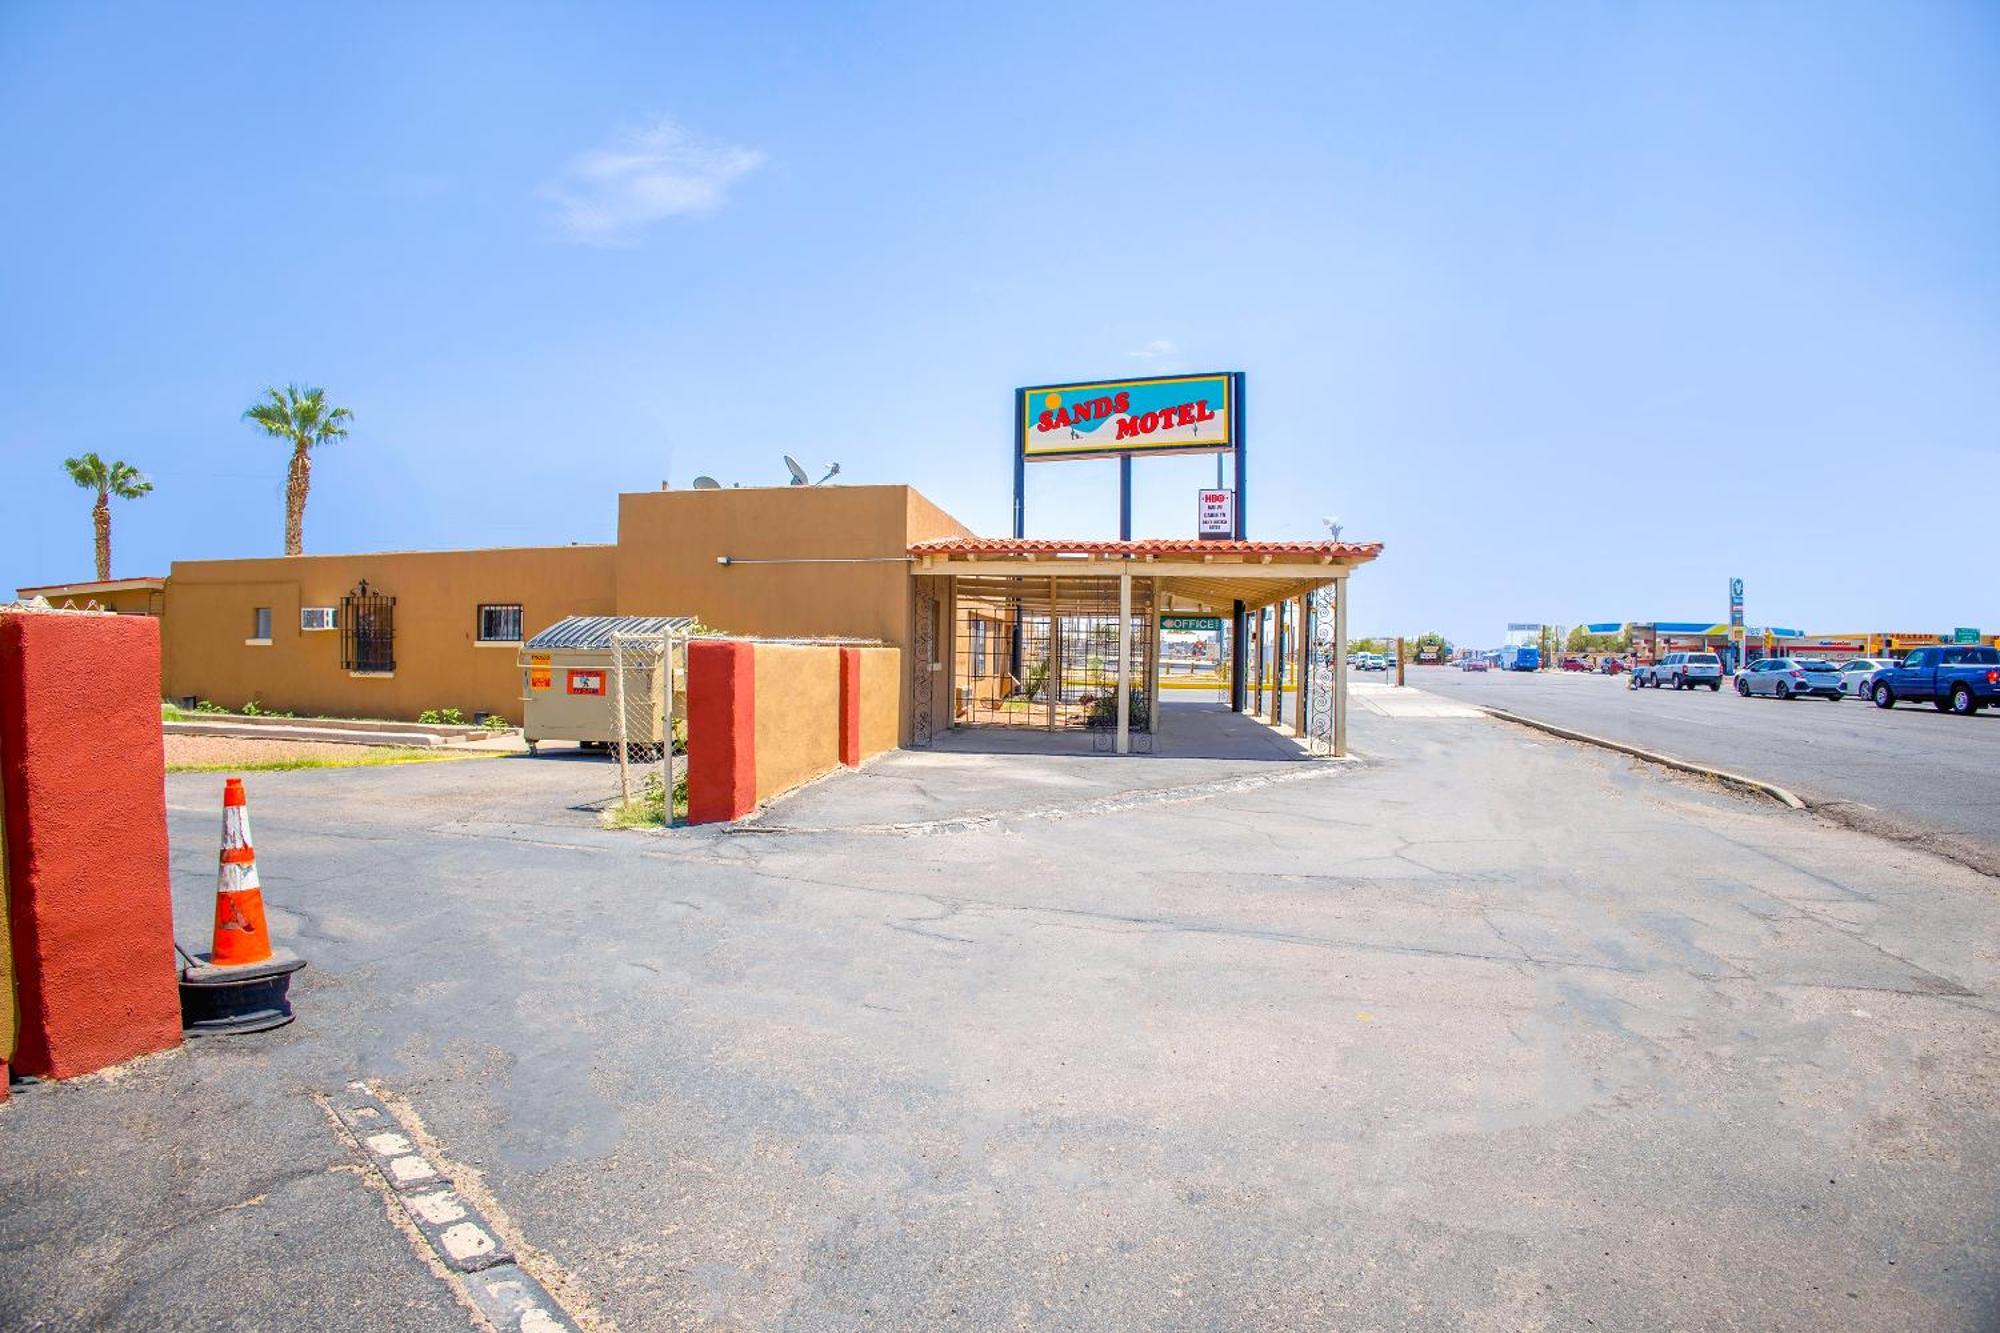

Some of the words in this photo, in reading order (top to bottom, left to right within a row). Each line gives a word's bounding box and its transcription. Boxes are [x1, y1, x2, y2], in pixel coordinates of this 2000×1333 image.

[1037, 391, 1130, 432] SANDS
[1116, 399, 1216, 440] MOTEL
[1204, 494, 1225, 503] HBO
[1174, 619, 1214, 629] OFFICE
